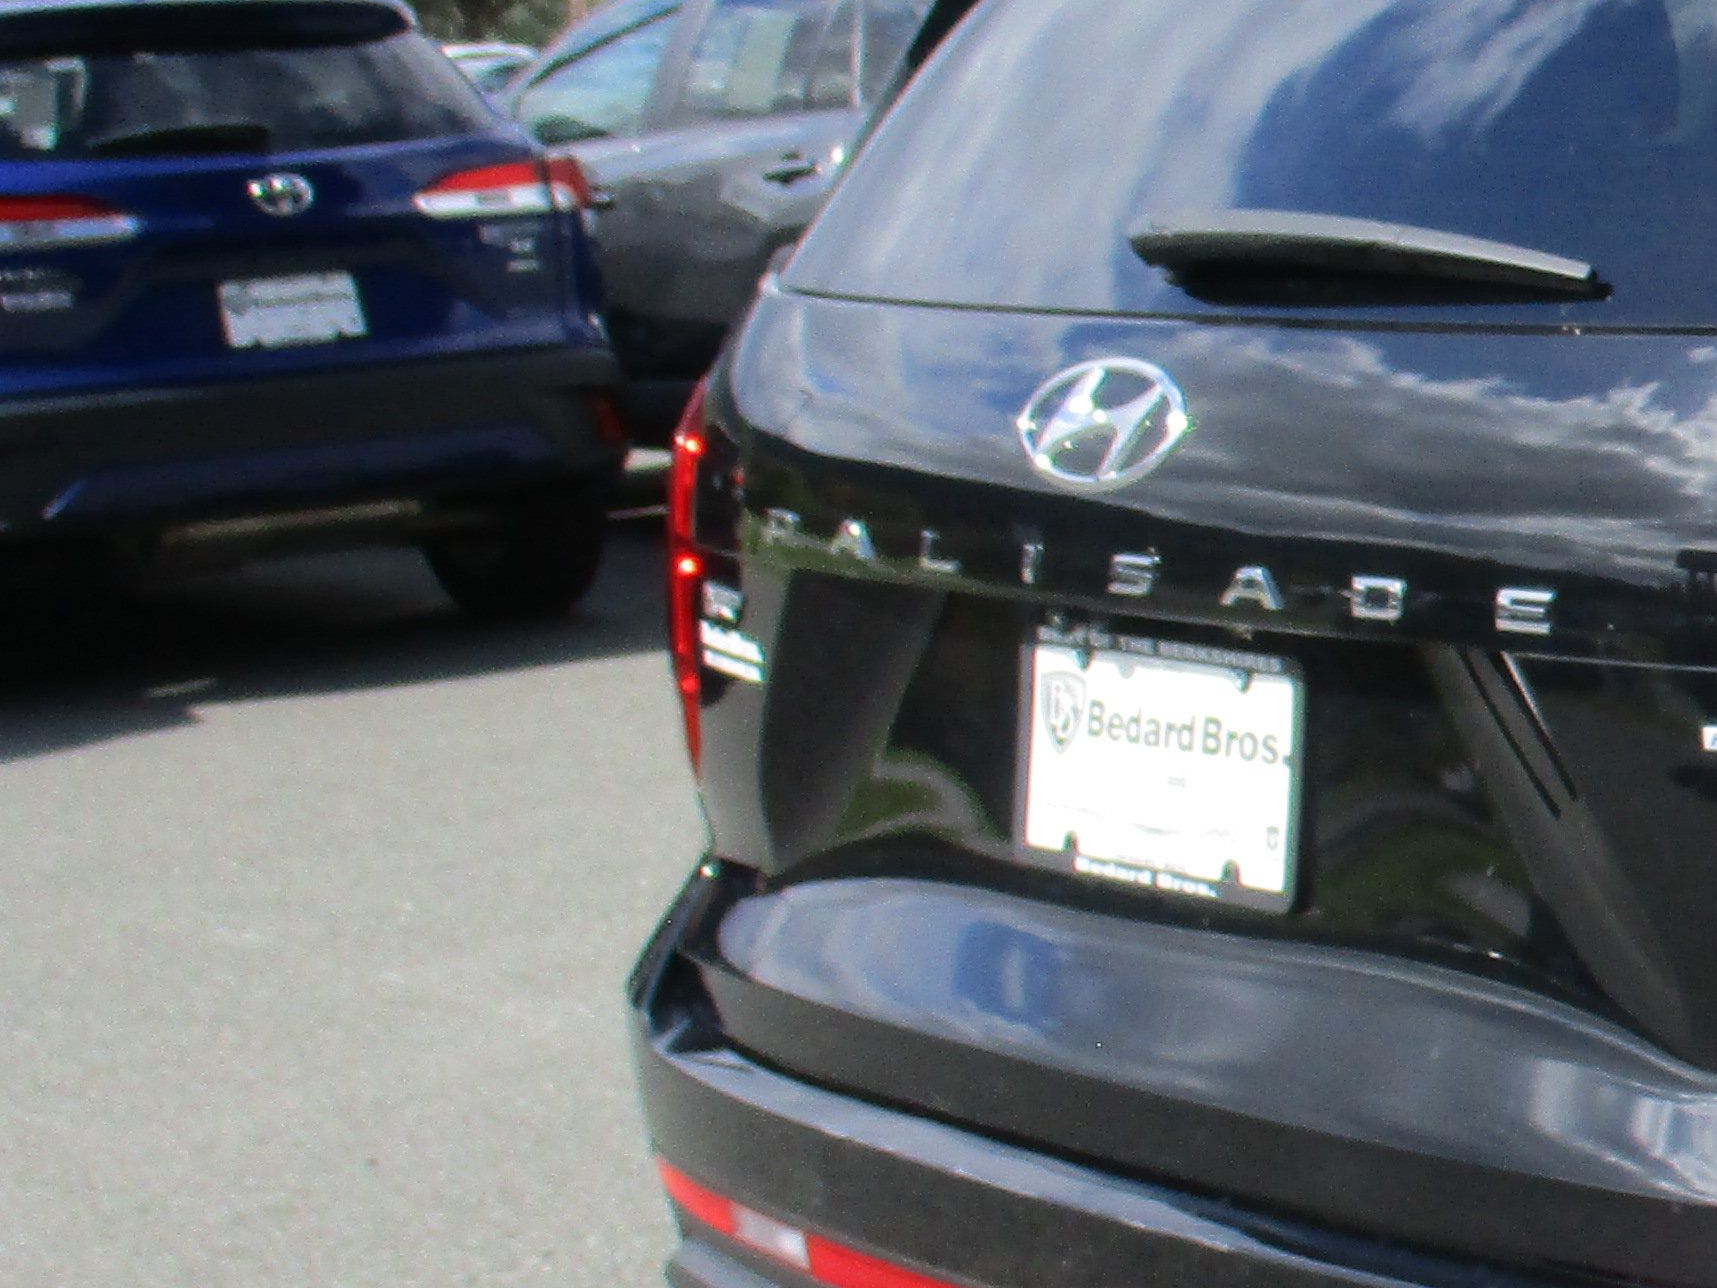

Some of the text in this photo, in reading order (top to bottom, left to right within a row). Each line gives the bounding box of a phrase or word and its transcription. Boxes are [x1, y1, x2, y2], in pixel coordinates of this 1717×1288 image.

[763, 508, 1556, 636] PALISADE
[1086, 698, 1196, 753] Bedard
[1075, 855, 1153, 886] Bedard
